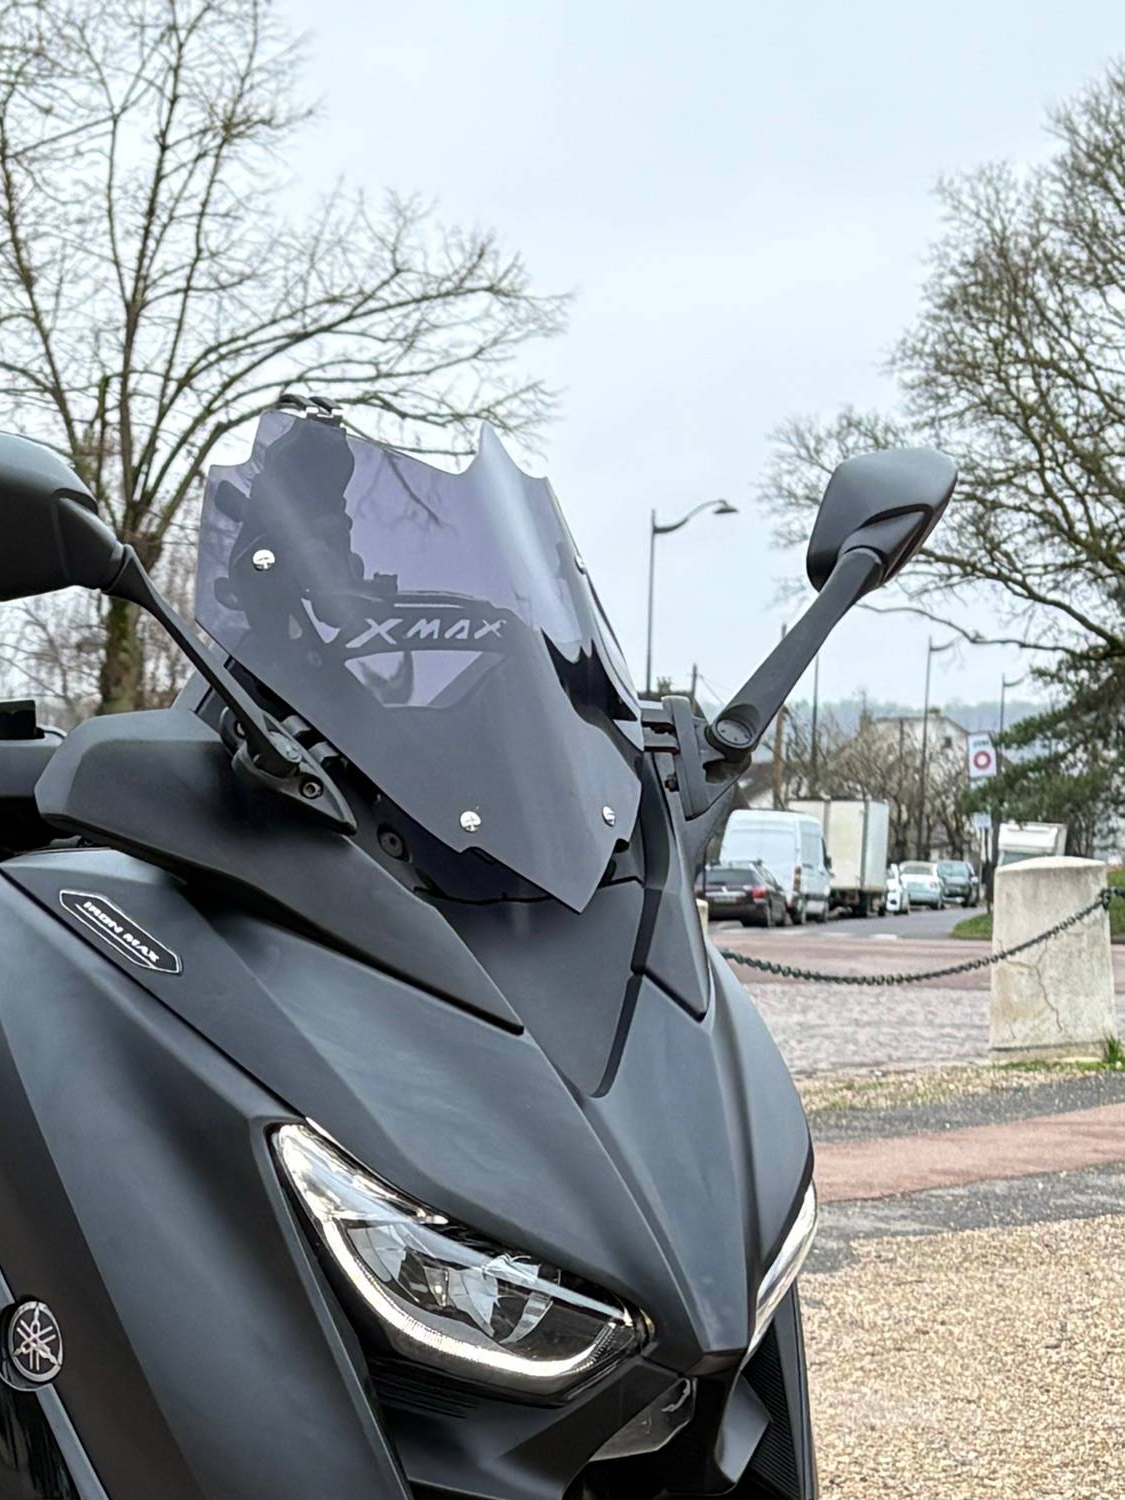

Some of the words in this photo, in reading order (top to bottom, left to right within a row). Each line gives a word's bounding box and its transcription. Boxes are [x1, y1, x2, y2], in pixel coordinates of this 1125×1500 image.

[345, 617, 507, 649] XMAX
[82, 901, 124, 934] IRON
[122, 932, 160, 963] MAX
